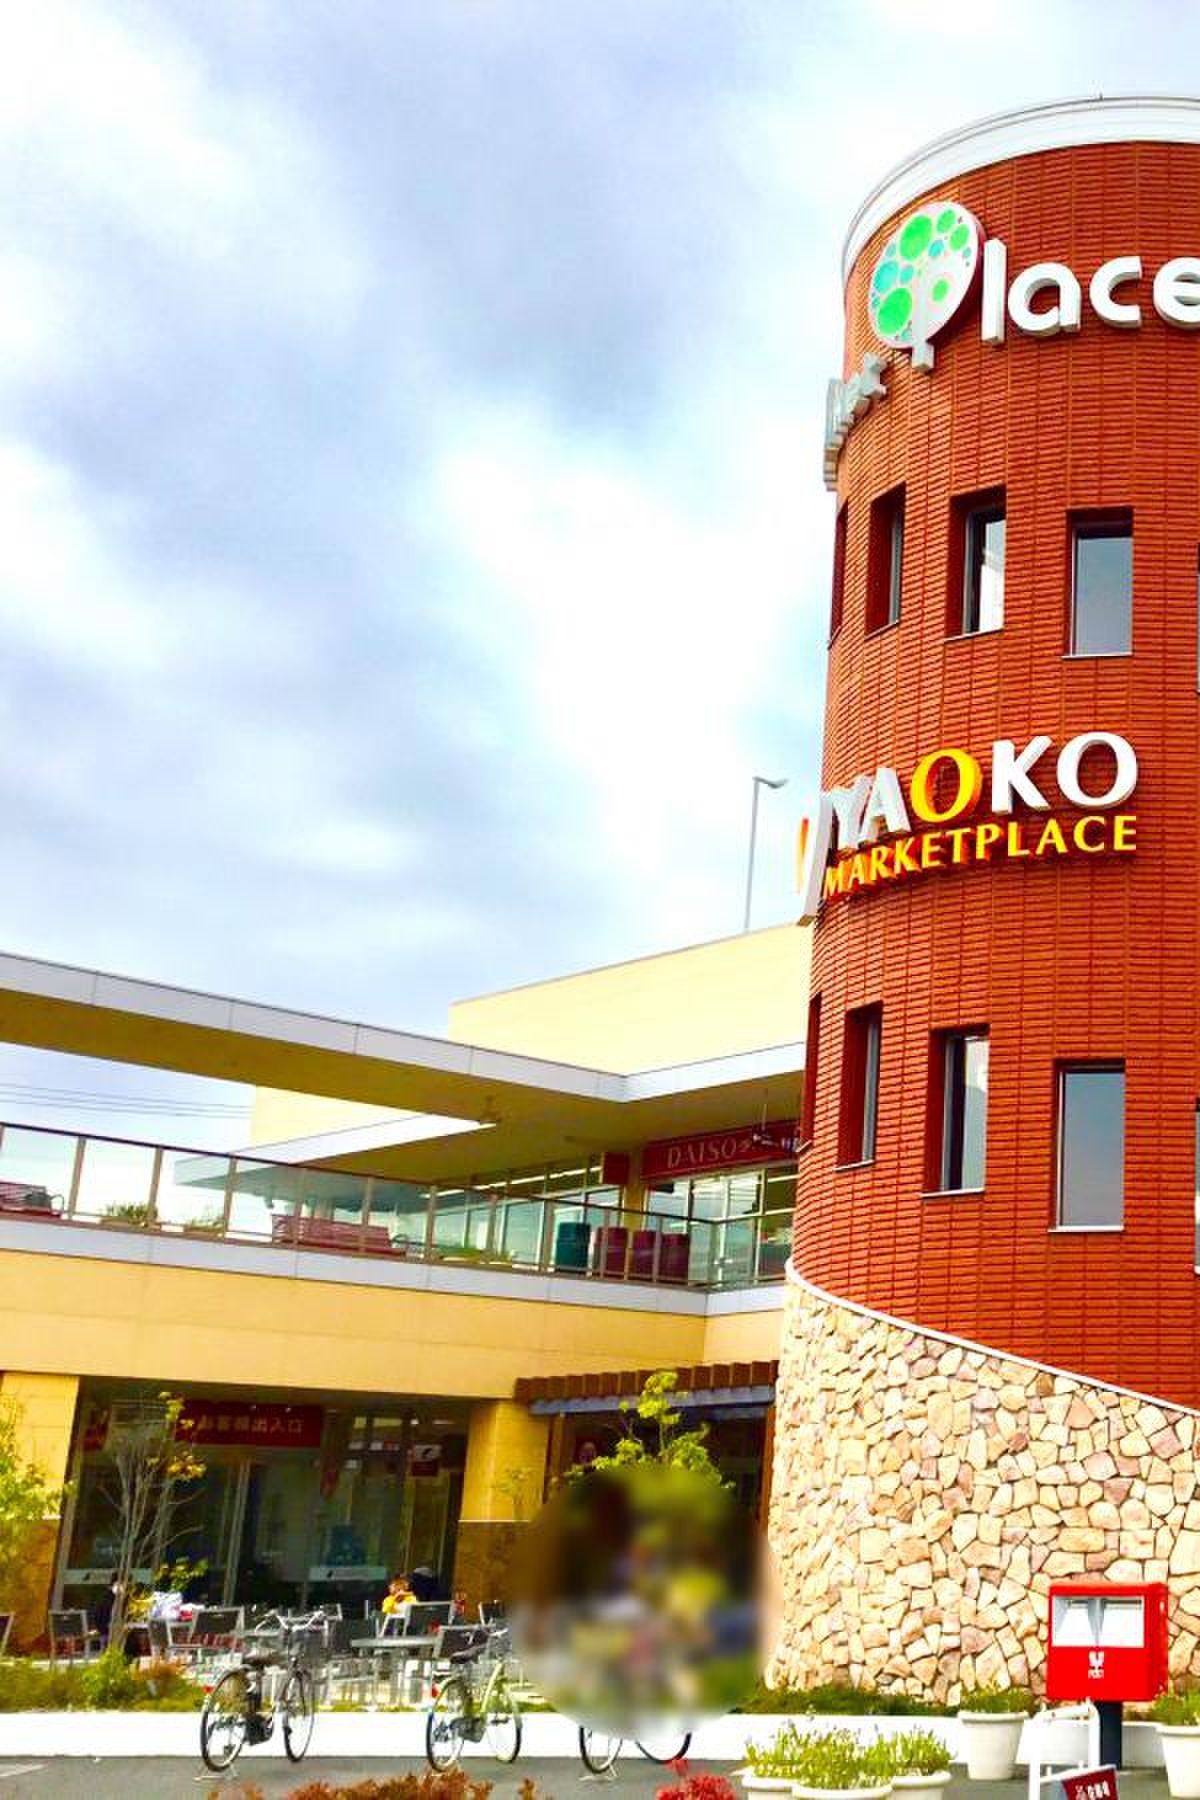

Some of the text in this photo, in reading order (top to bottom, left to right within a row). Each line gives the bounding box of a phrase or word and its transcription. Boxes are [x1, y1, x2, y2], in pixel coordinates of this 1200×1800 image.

[821, 731, 1139, 850] YAOKO
[824, 815, 1137, 898] MARKETPLACE
[667, 1136, 738, 1170] DAISO
